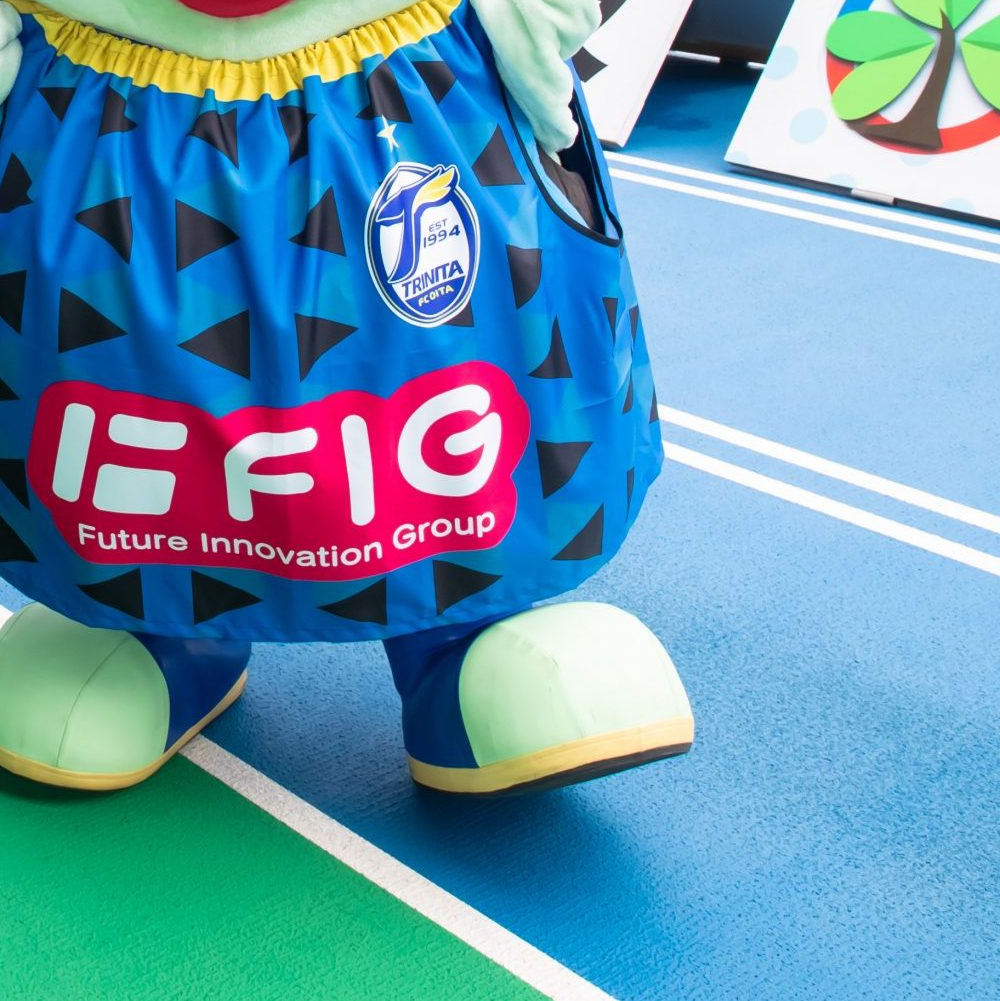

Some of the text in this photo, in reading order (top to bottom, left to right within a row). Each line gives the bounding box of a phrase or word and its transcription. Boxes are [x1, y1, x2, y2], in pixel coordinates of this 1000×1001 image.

[423, 224, 460, 248] 1994
[428, 218, 447, 232] EST
[401, 259, 464, 298] TRINITA
[78, 511, 496, 568] Future Innovation Group
